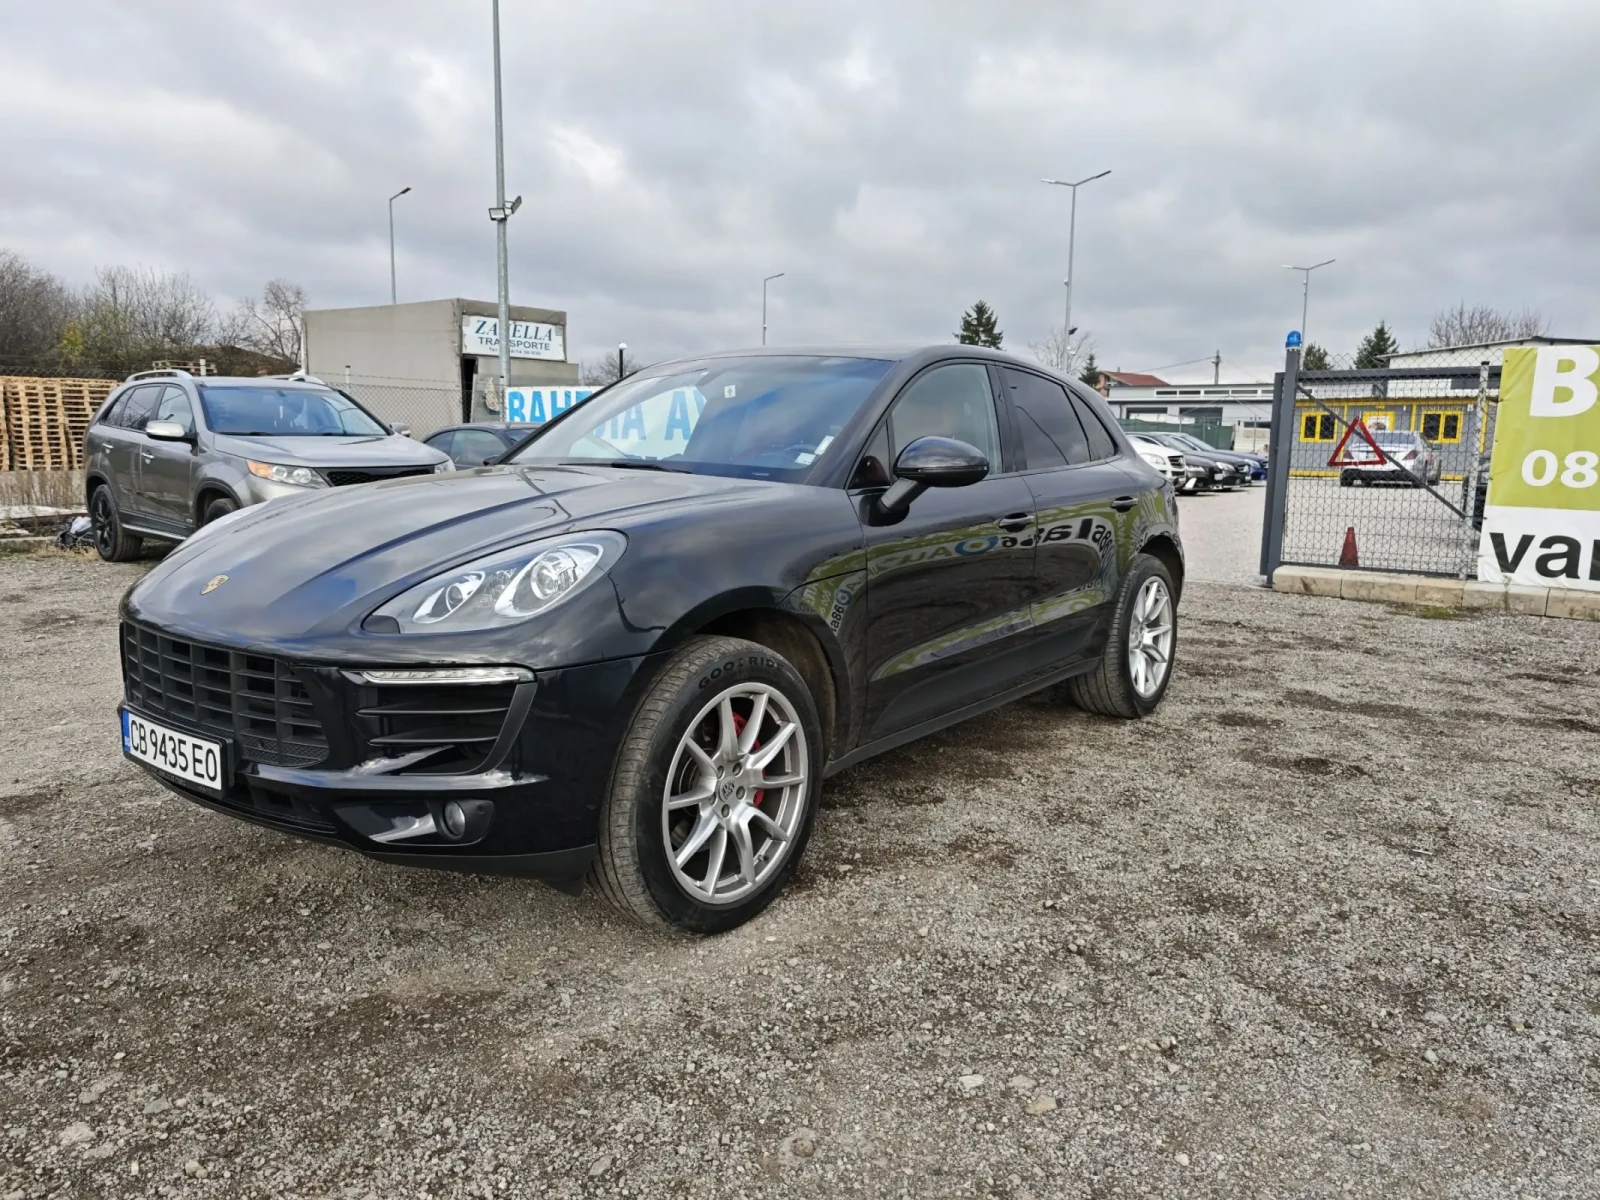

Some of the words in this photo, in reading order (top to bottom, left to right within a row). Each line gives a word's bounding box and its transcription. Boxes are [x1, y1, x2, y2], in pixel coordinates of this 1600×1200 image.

[475, 320, 552, 341] ZAELLA
[478, 337, 551, 351] TRASPORTE
[1521, 449, 1600, 488] 08
[1489, 532, 1600, 581] va
